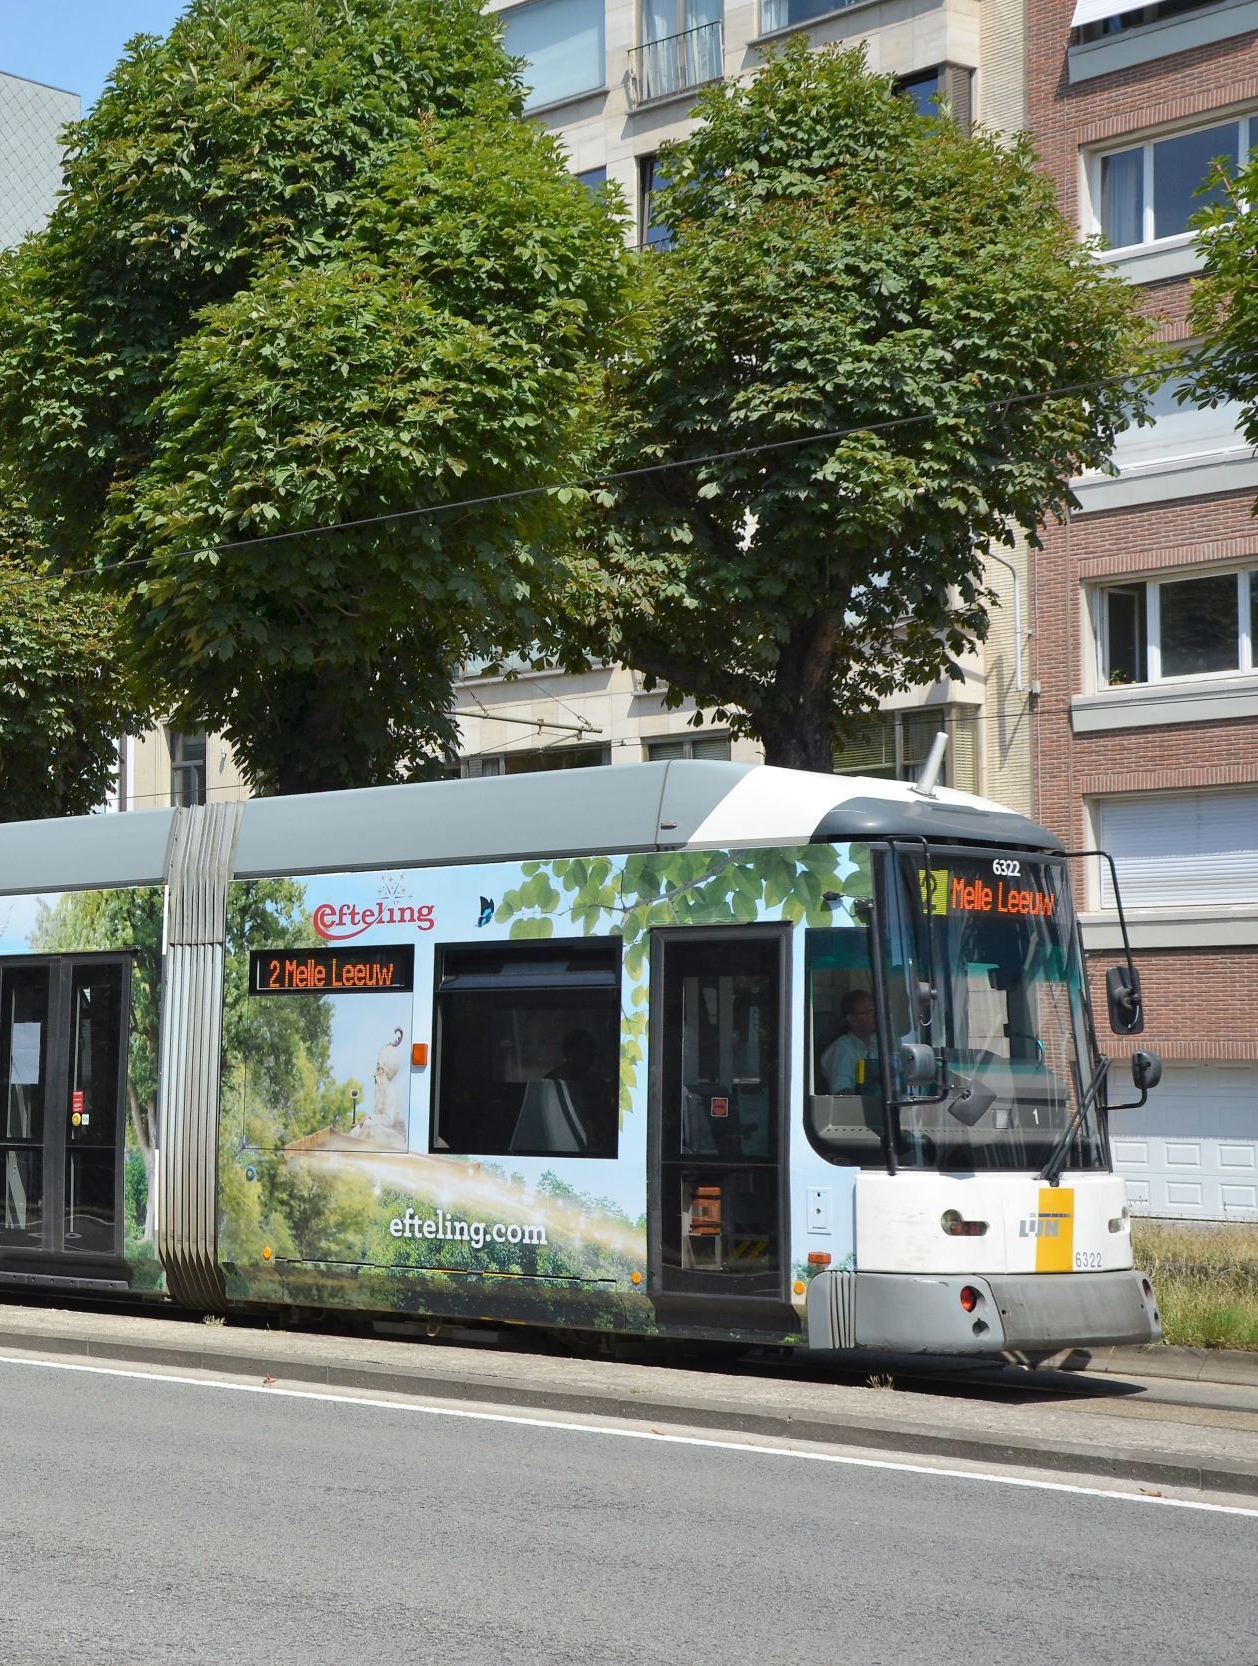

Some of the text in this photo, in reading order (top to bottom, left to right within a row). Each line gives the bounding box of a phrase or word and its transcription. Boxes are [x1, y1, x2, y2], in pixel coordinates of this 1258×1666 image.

[992, 858, 1022, 877] 6322
[951, 877, 993, 911] Melle
[997, 881, 1055, 916] Leeuw
[268, 958, 394, 988] 2 Melle Leeuw
[1032, 1108, 1040, 1125] 1
[389, 1207, 548, 1249] efteling.com
[1075, 1251, 1102, 1268] 6322
